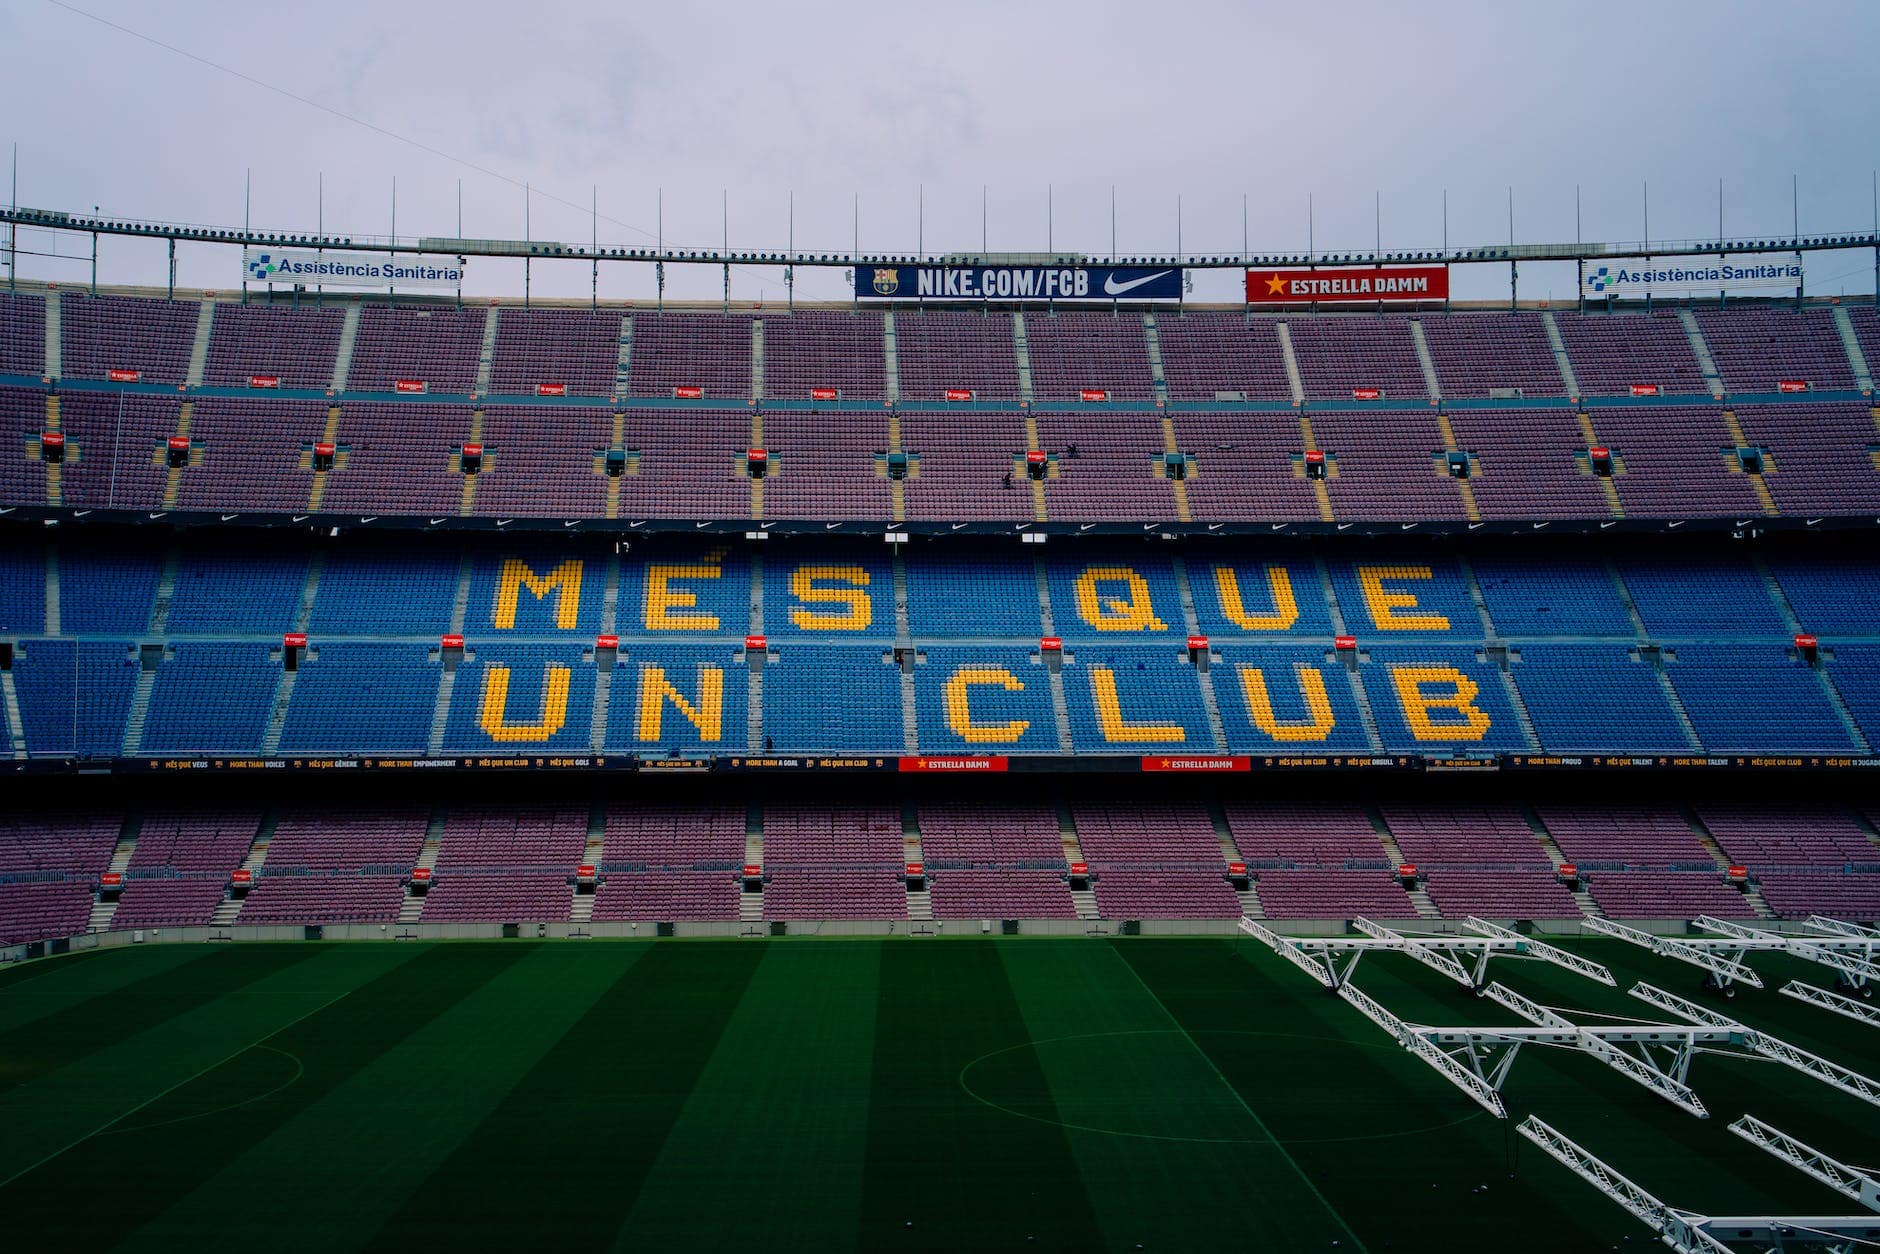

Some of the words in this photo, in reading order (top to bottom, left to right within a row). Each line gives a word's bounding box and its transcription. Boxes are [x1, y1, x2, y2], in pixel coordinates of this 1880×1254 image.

[278, 258, 379, 277] Assistència
[382, 264, 459, 280] Sanitària
[1617, 268, 1719, 283] Assistència
[1722, 264, 1800, 280] Sanitària
[917, 269, 1089, 297] NIKE.COM/FCB
[1290, 278, 1373, 295] ESTRELLA
[1375, 277, 1428, 292] DAMM
[492, 546, 871, 630] MÉS
[1074, 566, 1451, 630] QUE
[478, 668, 723, 742] UN
[942, 667, 1491, 742] CLUB
[928, 761, 965, 769] ESTRELLA
[966, 761, 989, 769] DAMM
